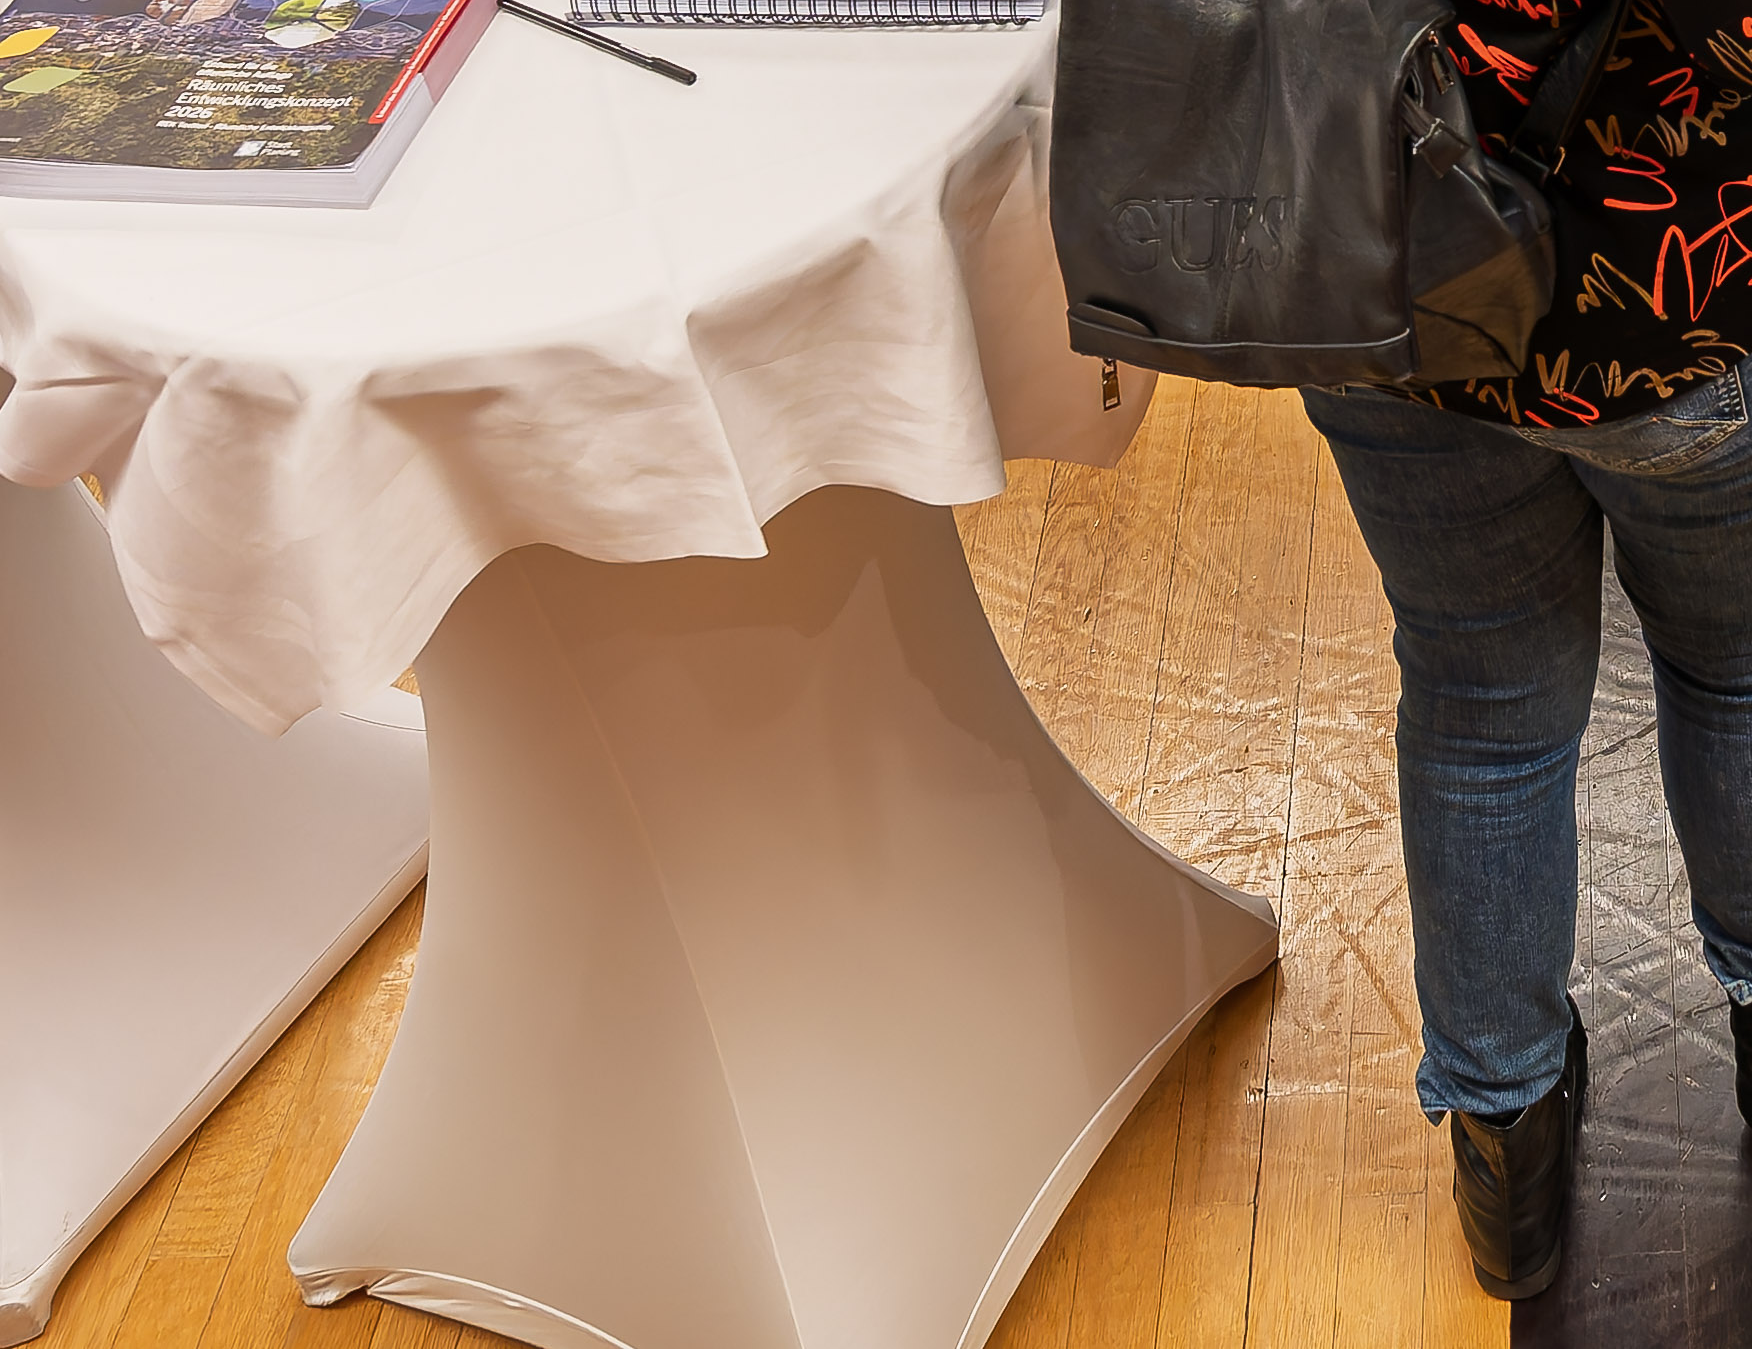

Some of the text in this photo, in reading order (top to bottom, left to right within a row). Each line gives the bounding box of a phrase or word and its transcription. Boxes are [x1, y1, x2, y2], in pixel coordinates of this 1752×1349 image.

[186, 79, 286, 94] Räumliches
[176, 92, 354, 109] Entwicklungskonzept
[164, 105, 215, 119] 2026
